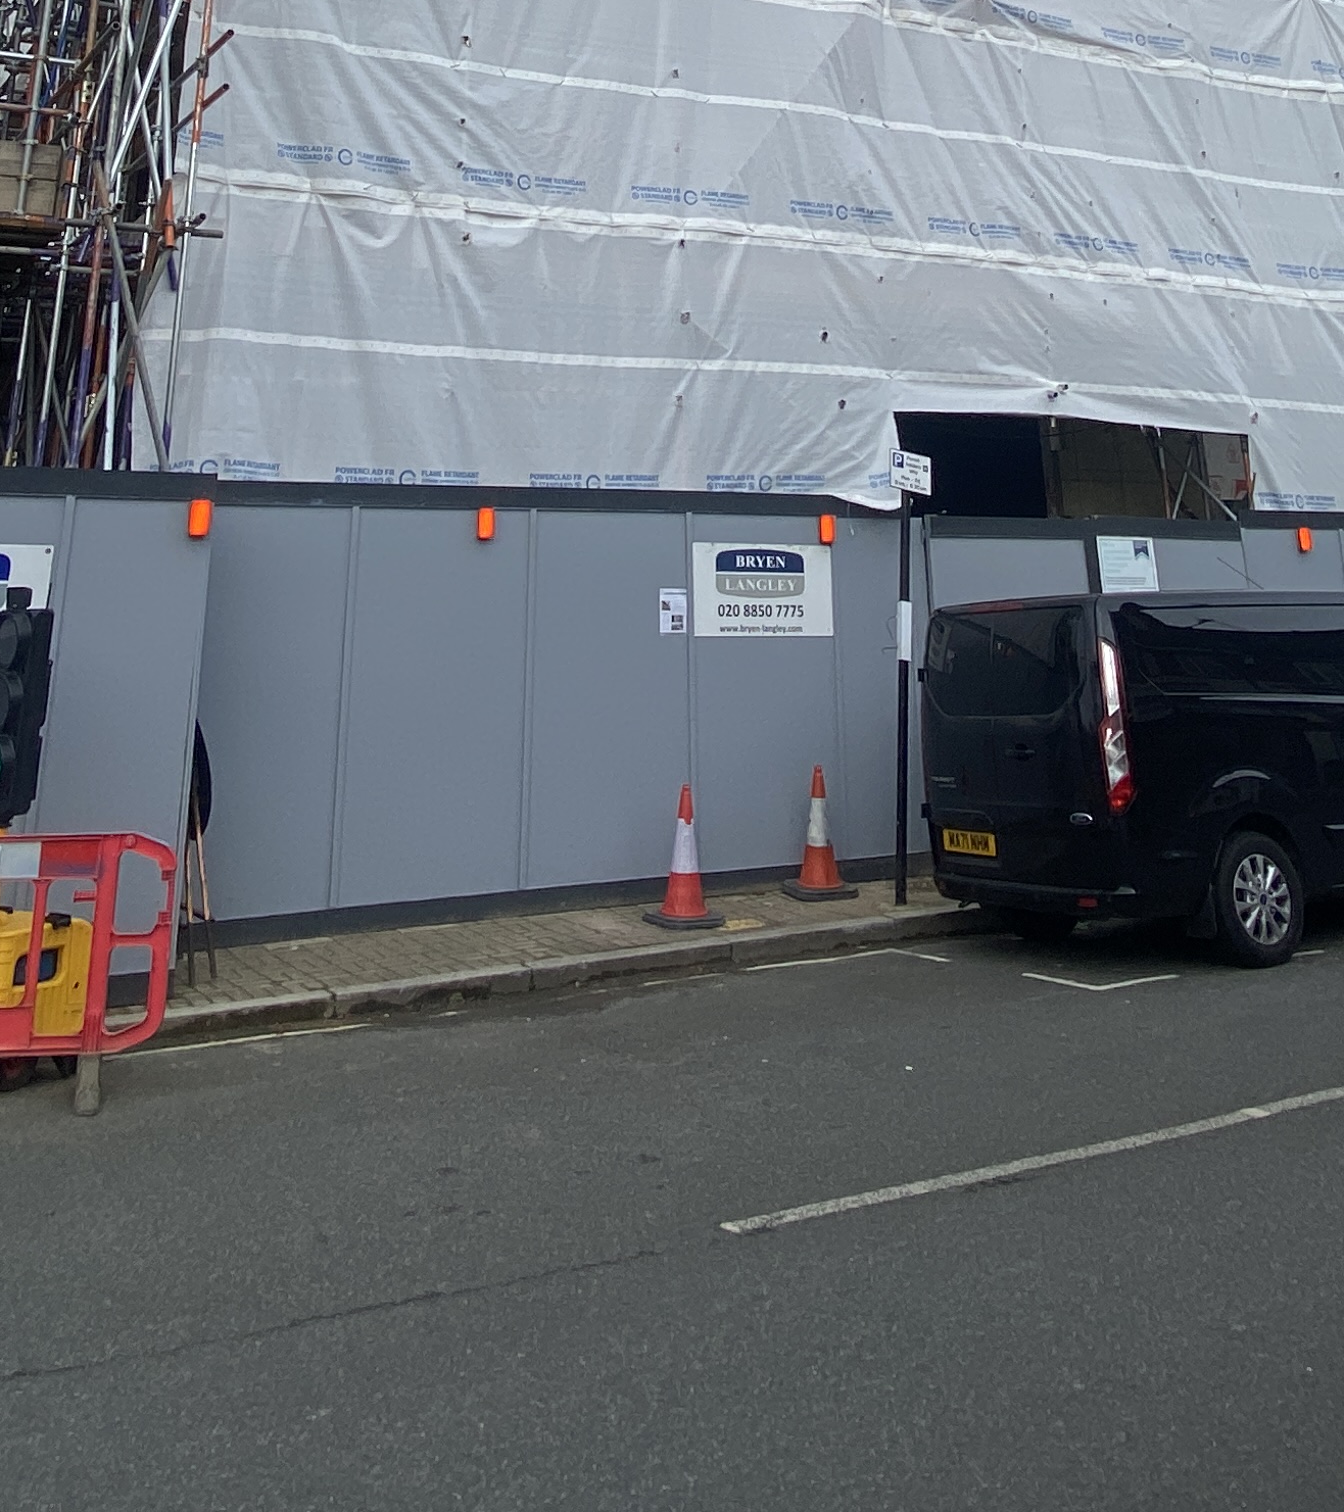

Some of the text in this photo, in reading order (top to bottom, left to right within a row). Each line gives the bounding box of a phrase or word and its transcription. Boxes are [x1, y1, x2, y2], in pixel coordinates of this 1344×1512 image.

[735, 555, 786, 568] BRYEN
[725, 578, 797, 592] LANGLEY
[718, 604, 804, 618] 020 8850 7775
